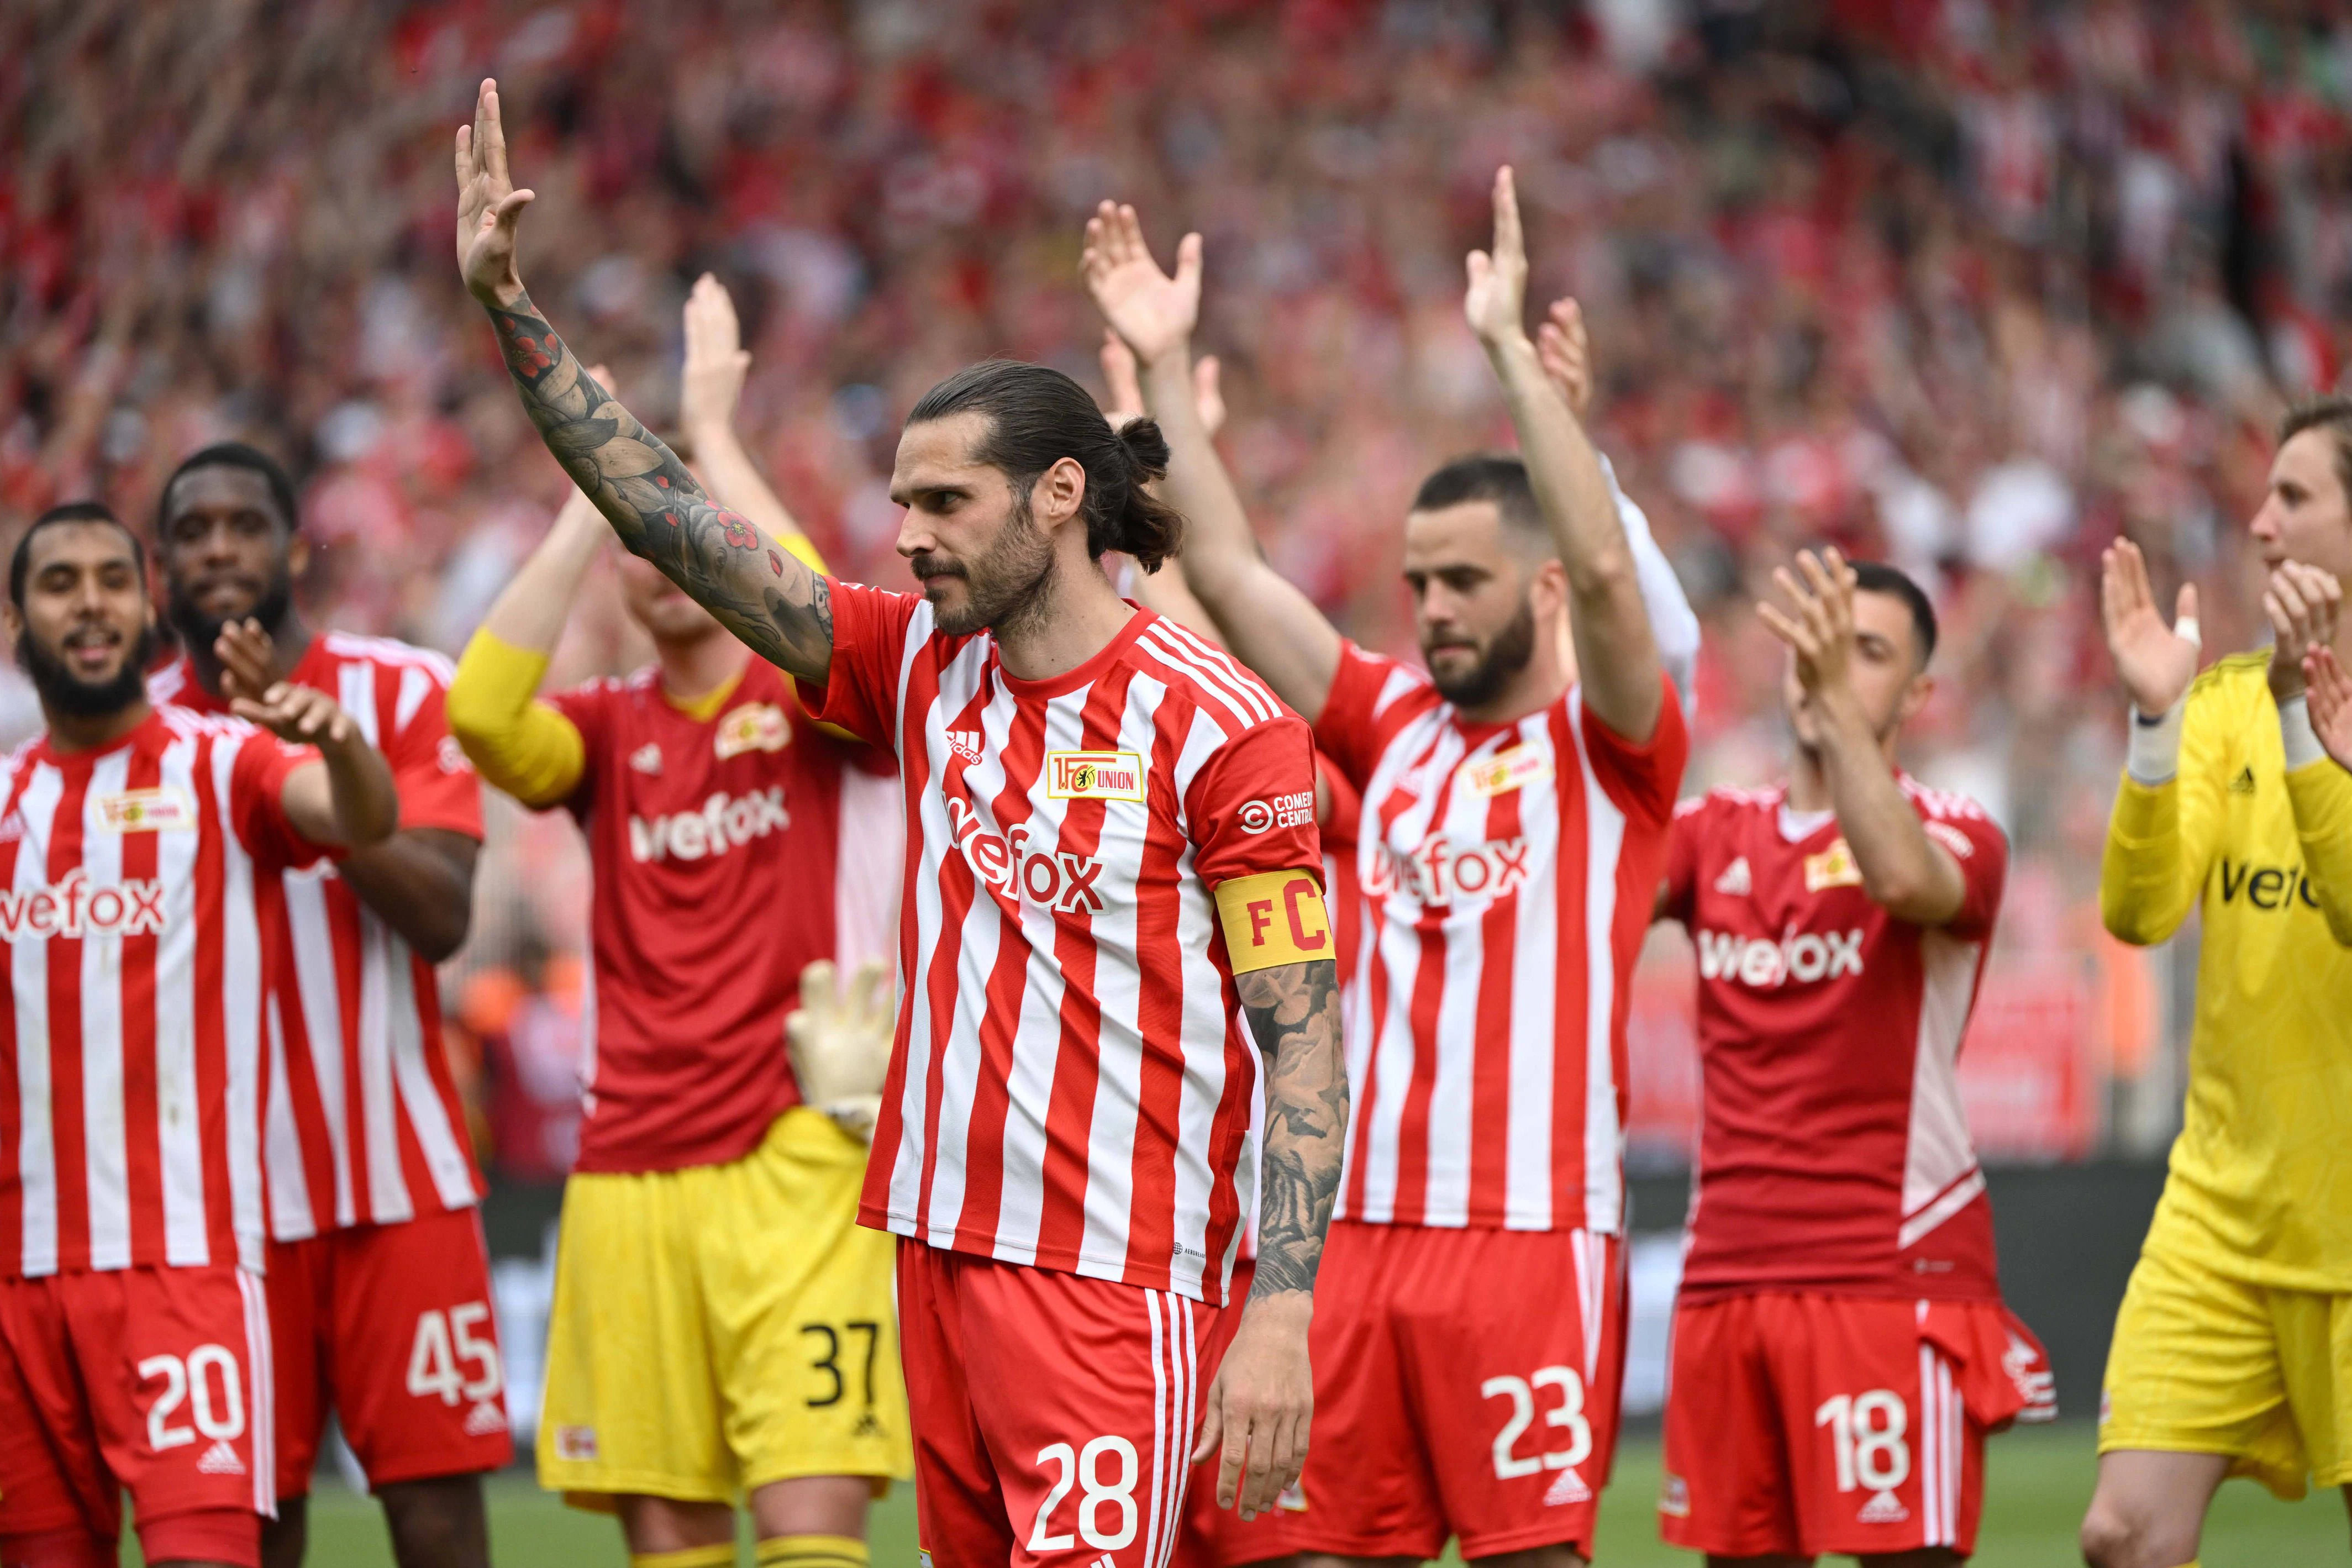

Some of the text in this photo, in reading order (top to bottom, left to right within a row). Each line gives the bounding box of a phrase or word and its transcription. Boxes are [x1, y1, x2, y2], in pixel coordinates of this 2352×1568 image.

[628, 785, 790, 863] wefox
[1097, 770, 1134, 790] UNION
[1274, 791, 1313, 812] COMEDY
[1277, 807, 1313, 828] CENTRAL
[138, 1344, 245, 1451] 20
[407, 1302, 506, 1406] 45
[801, 1321, 878, 1406] 37
[1481, 1366, 1593, 1480] 23
[1816, 1389, 1910, 1492] 18
[1026, 1435, 1139, 1551] 28
